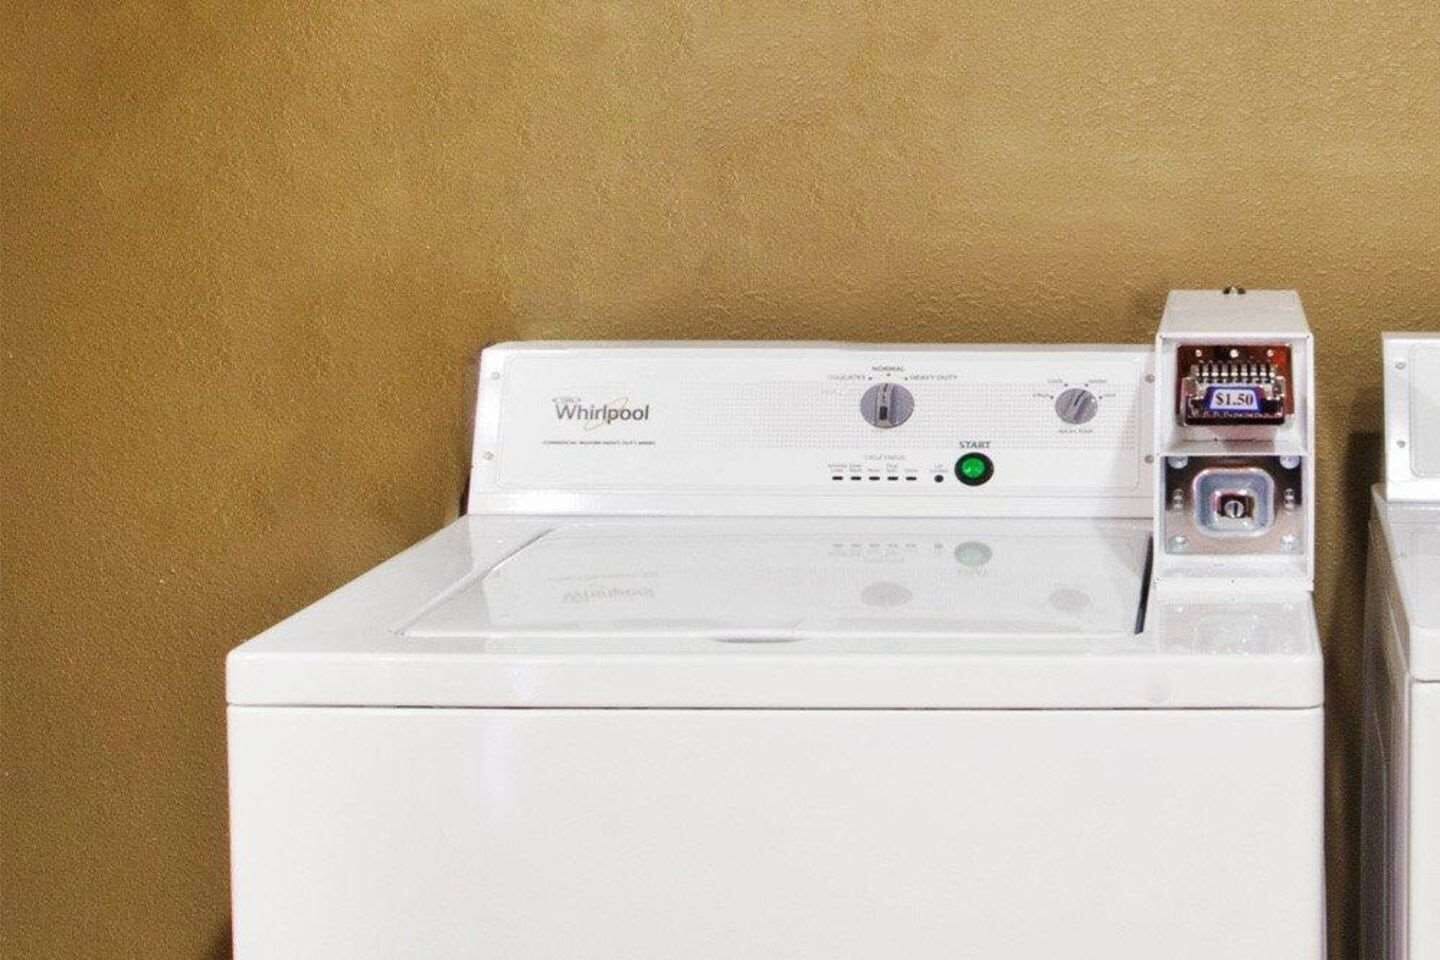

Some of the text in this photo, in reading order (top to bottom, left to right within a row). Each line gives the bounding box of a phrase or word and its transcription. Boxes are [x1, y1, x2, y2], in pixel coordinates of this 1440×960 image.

[1215, 392, 1254, 406] $1.50
[555, 404, 649, 424] Whirlpool
[959, 440, 992, 449] START
